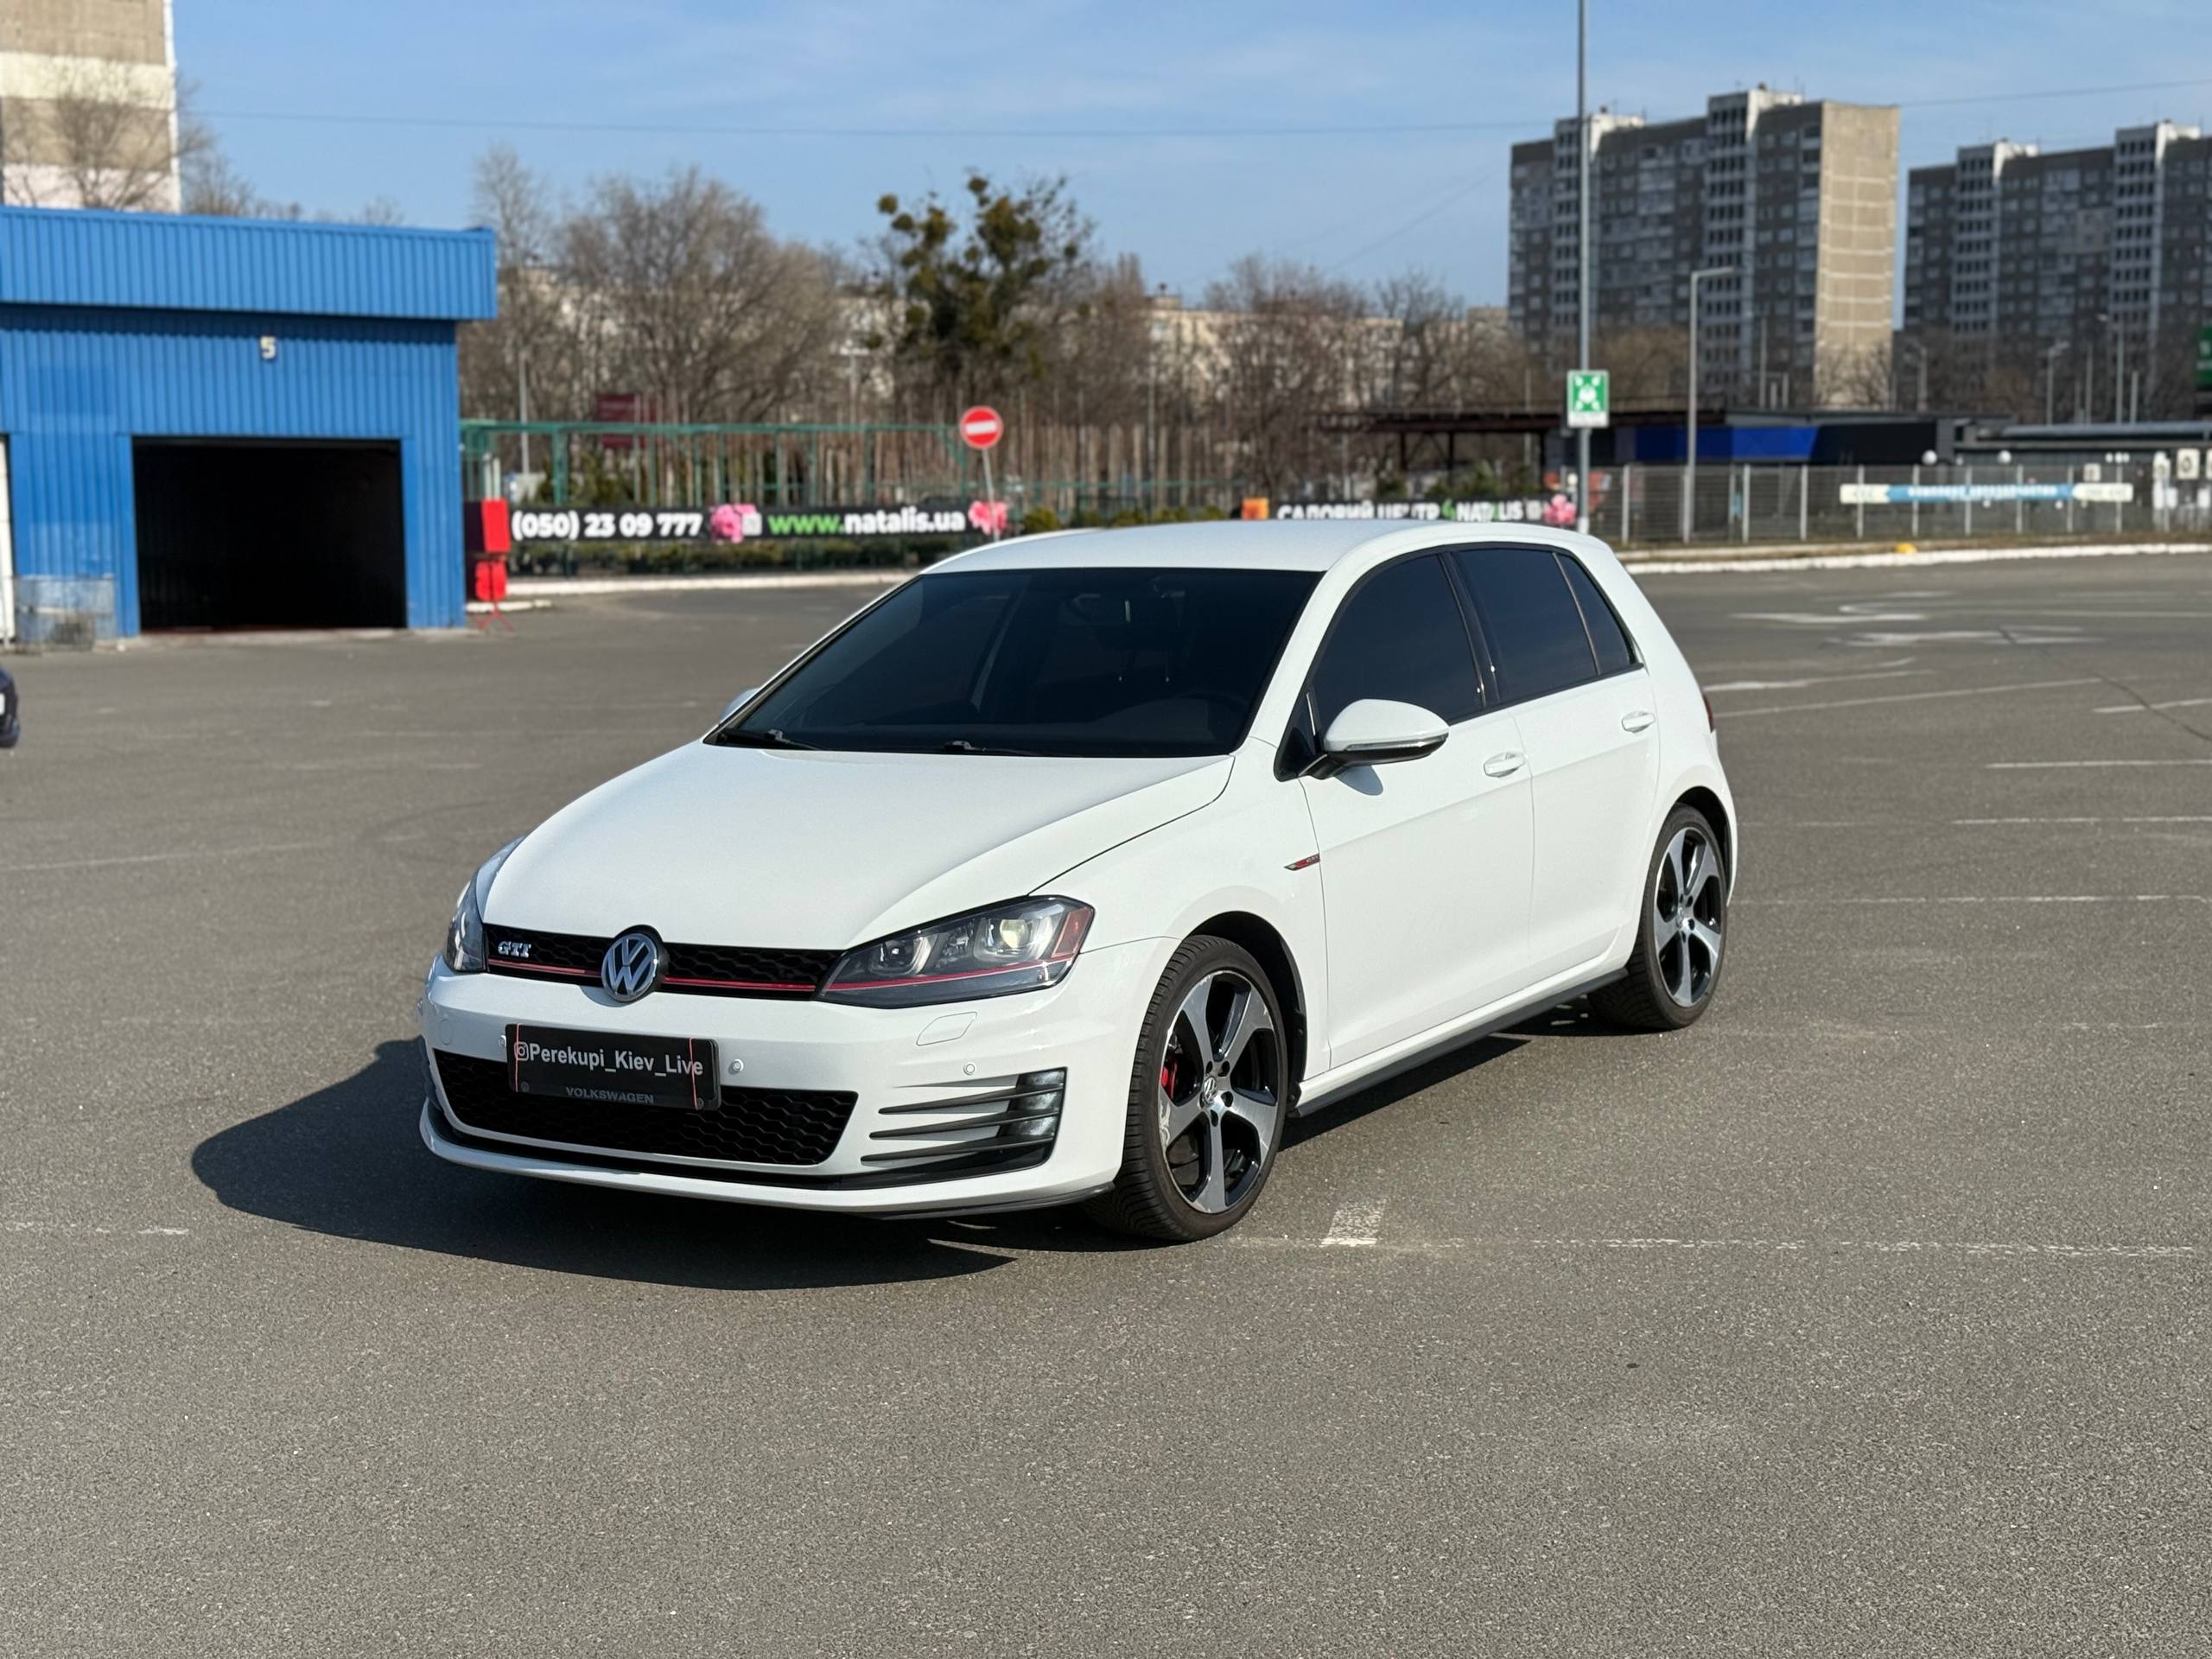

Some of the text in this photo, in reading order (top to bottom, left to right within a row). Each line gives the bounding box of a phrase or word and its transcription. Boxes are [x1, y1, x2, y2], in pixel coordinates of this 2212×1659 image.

[261, 336, 276, 359] 5
[512, 511, 702, 540] (050) 23 09 777
[768, 506, 966, 535] www.natalis.ua
[498, 941, 531, 957] GTI
[530, 1042, 703, 1077] Perekupi_Kiev_Live
[566, 1086, 654, 1103] VOLKSWAGEN
